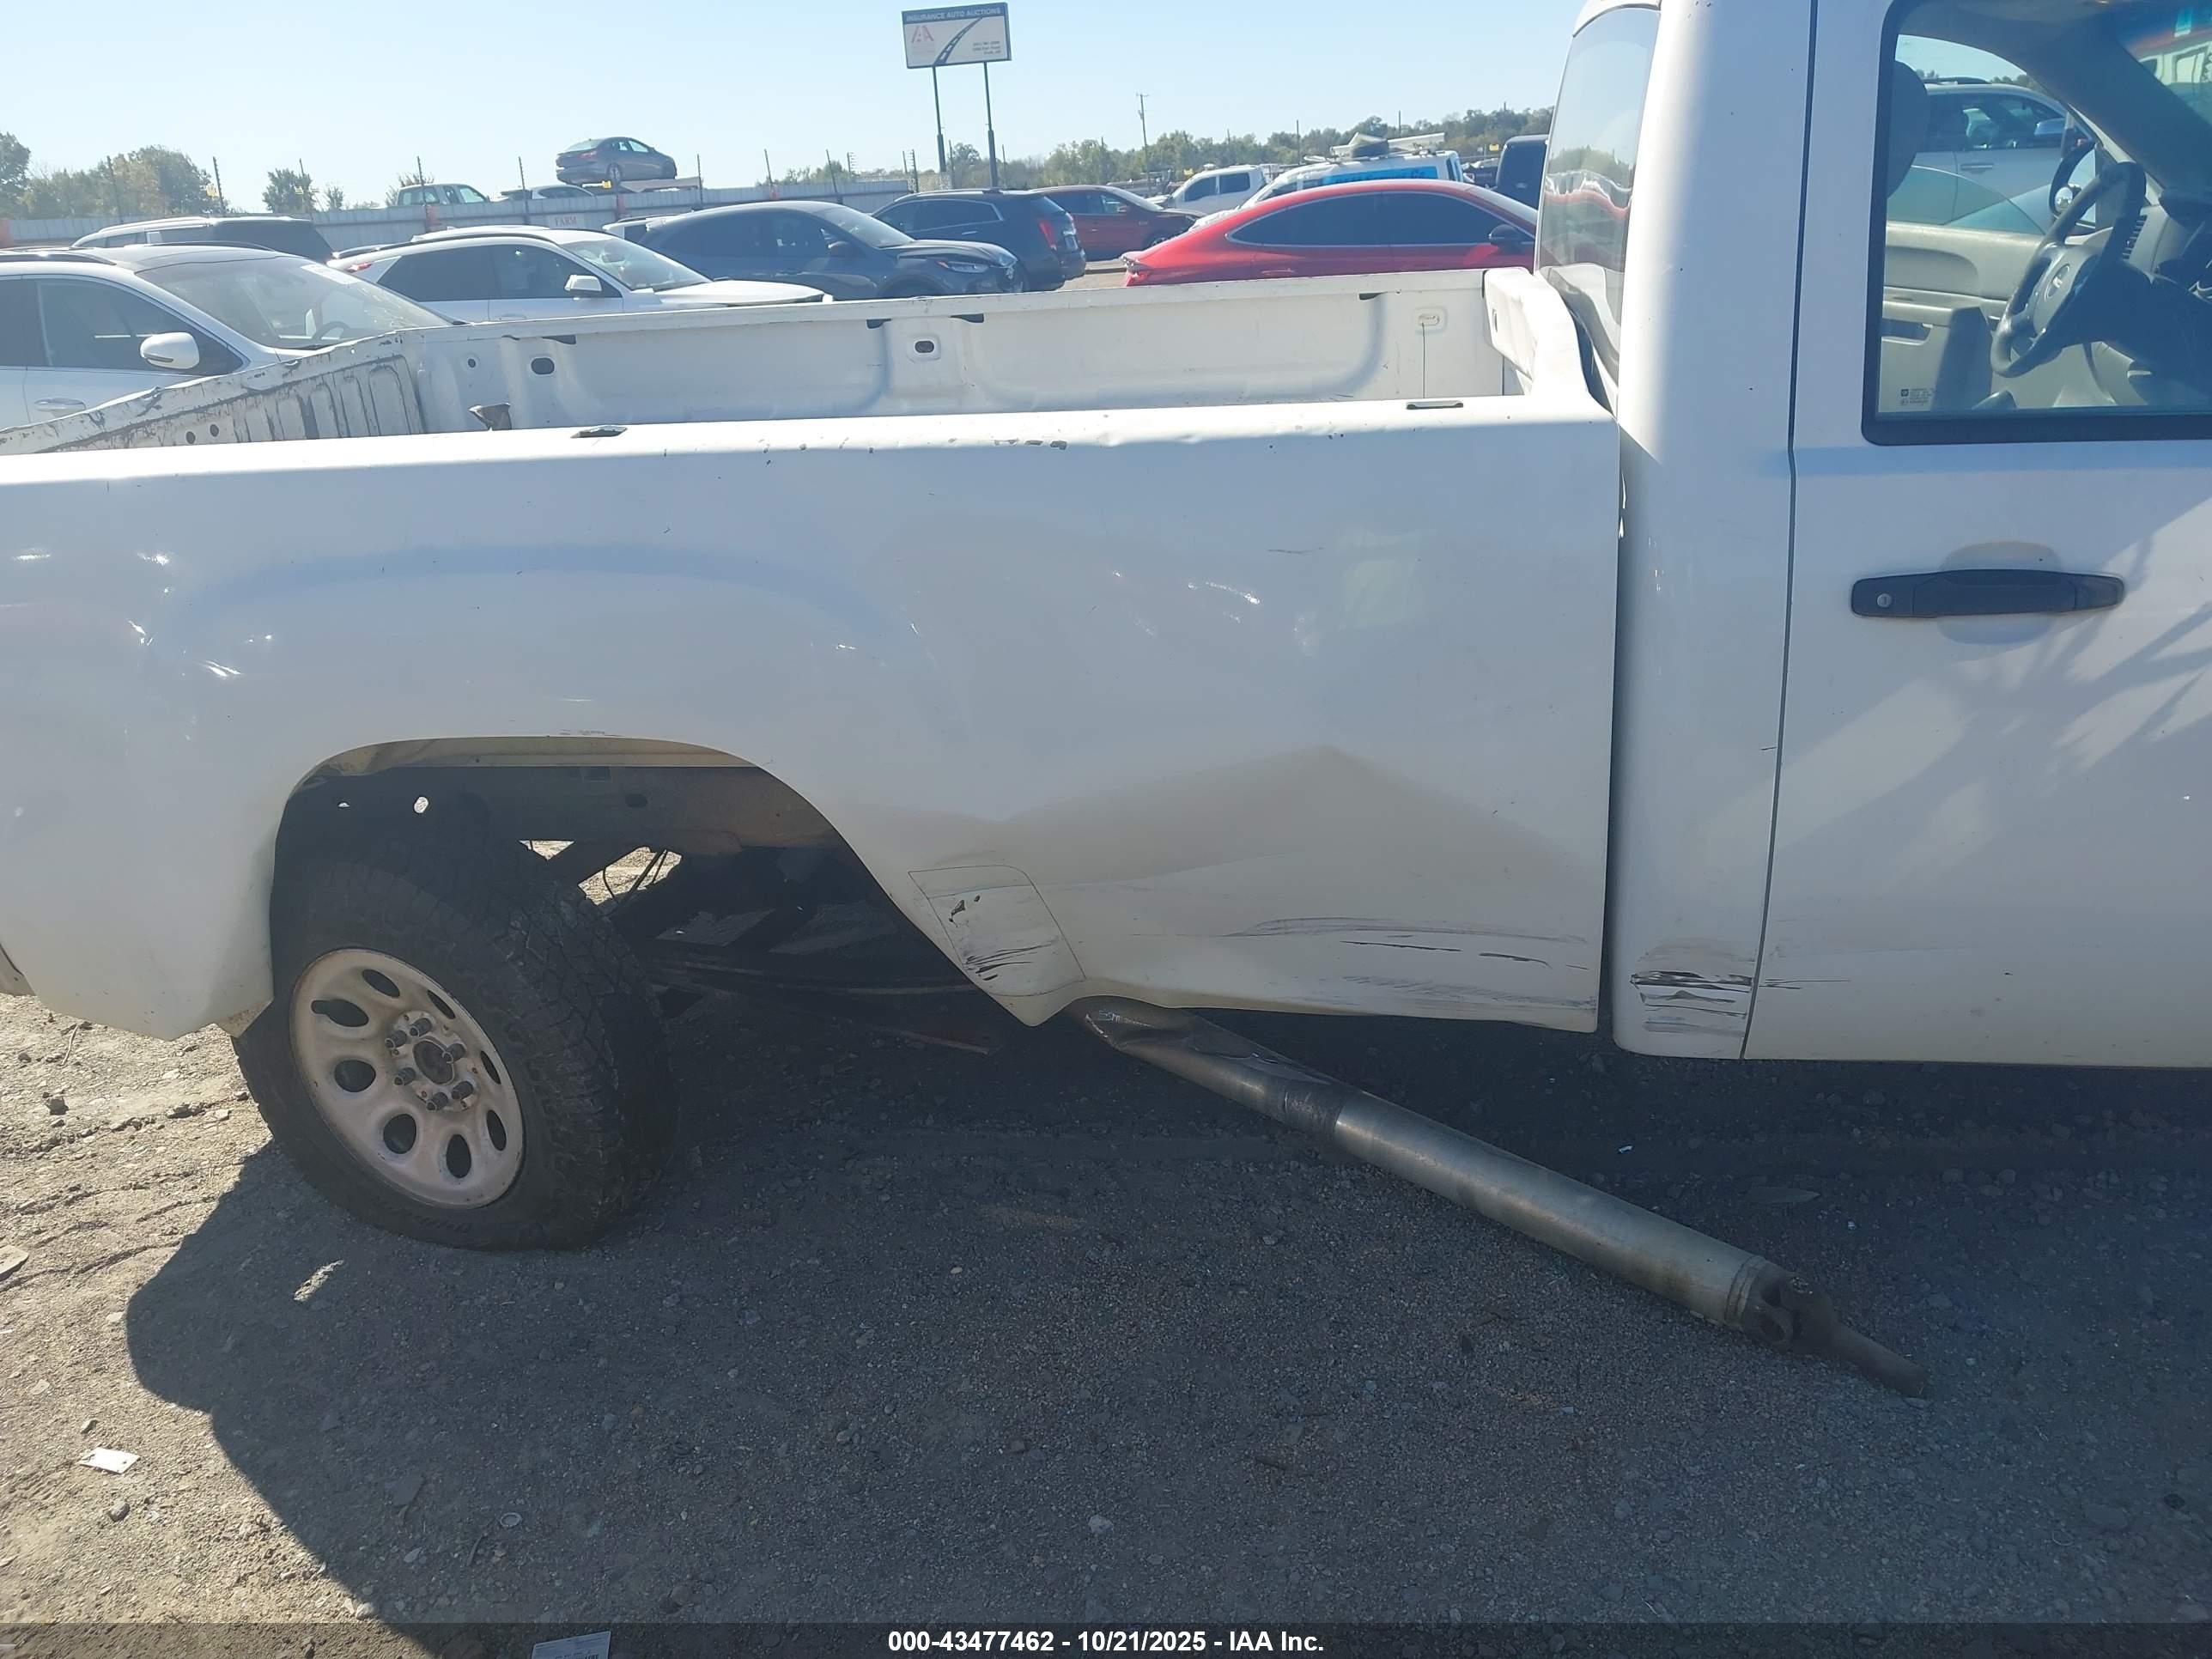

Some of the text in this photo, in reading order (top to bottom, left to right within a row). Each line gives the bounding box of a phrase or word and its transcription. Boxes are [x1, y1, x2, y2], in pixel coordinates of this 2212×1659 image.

[906, 7, 1001, 21] INSURANCE AUTO AUCTIONS
